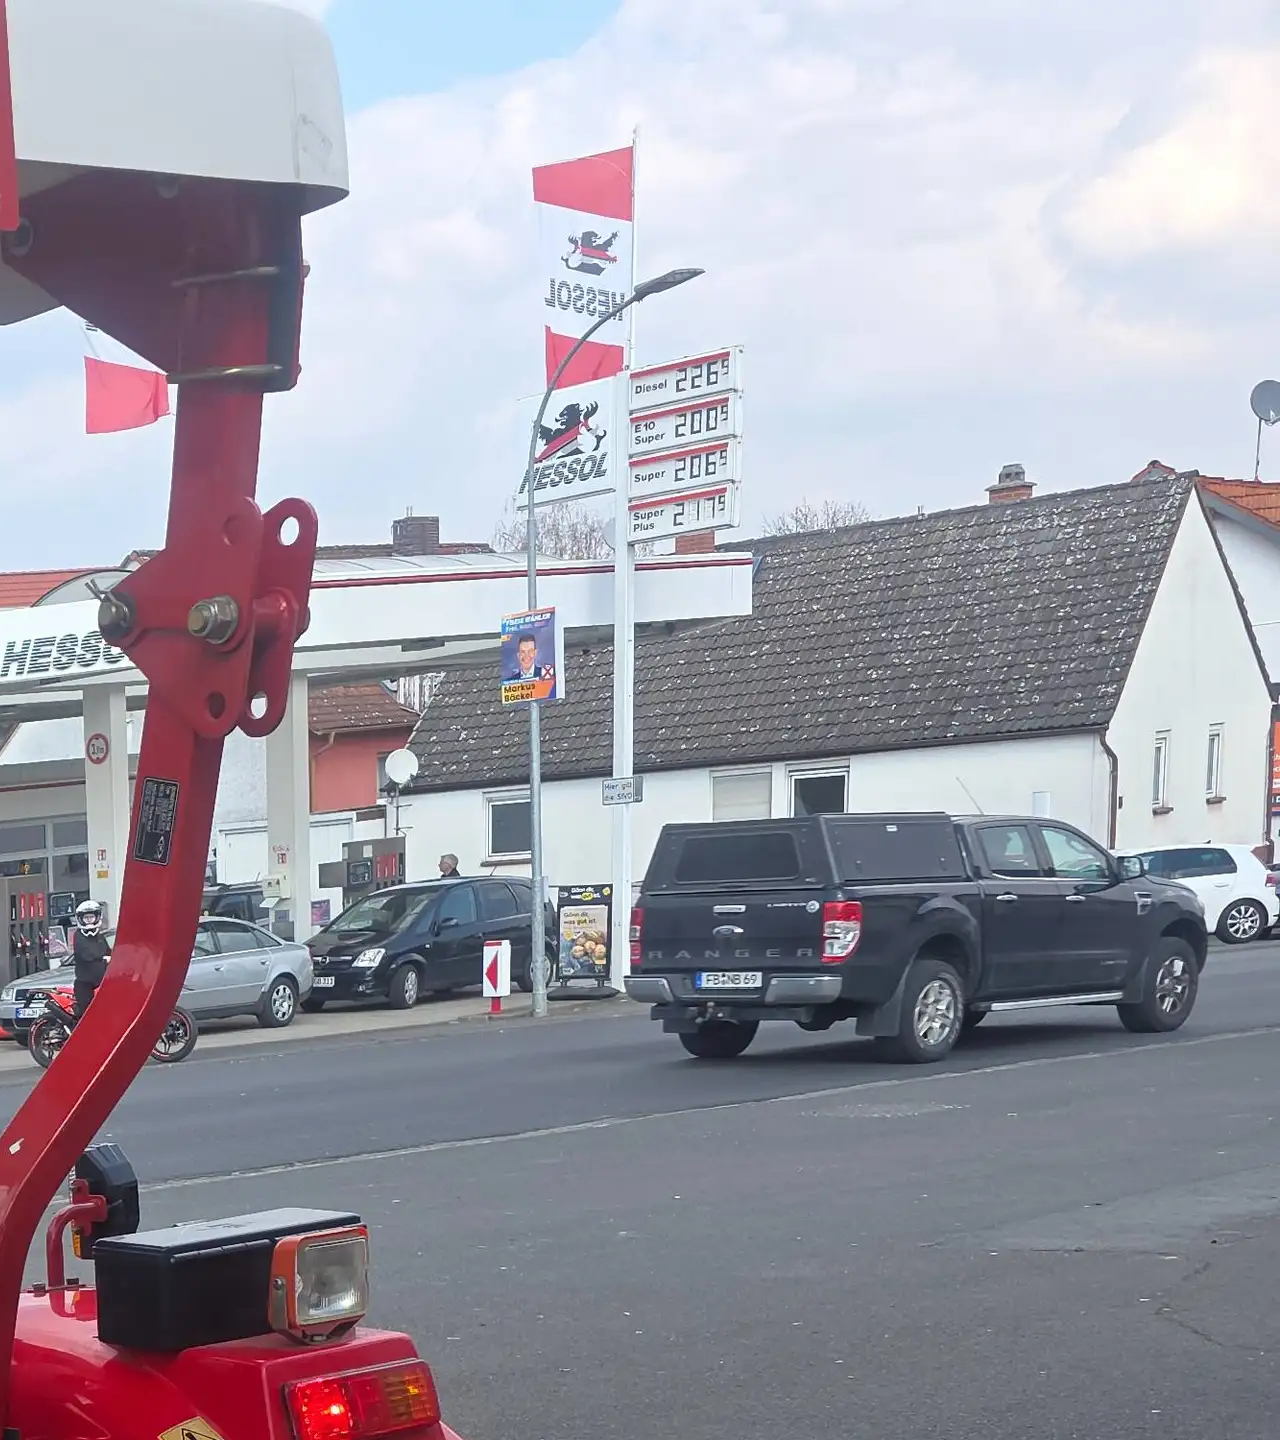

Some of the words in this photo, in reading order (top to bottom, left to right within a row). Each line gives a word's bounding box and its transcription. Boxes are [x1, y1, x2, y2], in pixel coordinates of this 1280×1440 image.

[635, 379, 667, 394] Diesel
[634, 421, 655, 433] E10
[634, 433, 665, 445] Super
[634, 470, 666, 482] Super
[633, 509, 665, 521] Super
[633, 522, 655, 532] Plus
[504, 683, 535, 693] Markus
[648, 948, 813, 960] RANGER
[743, 973, 757, 984] 69
